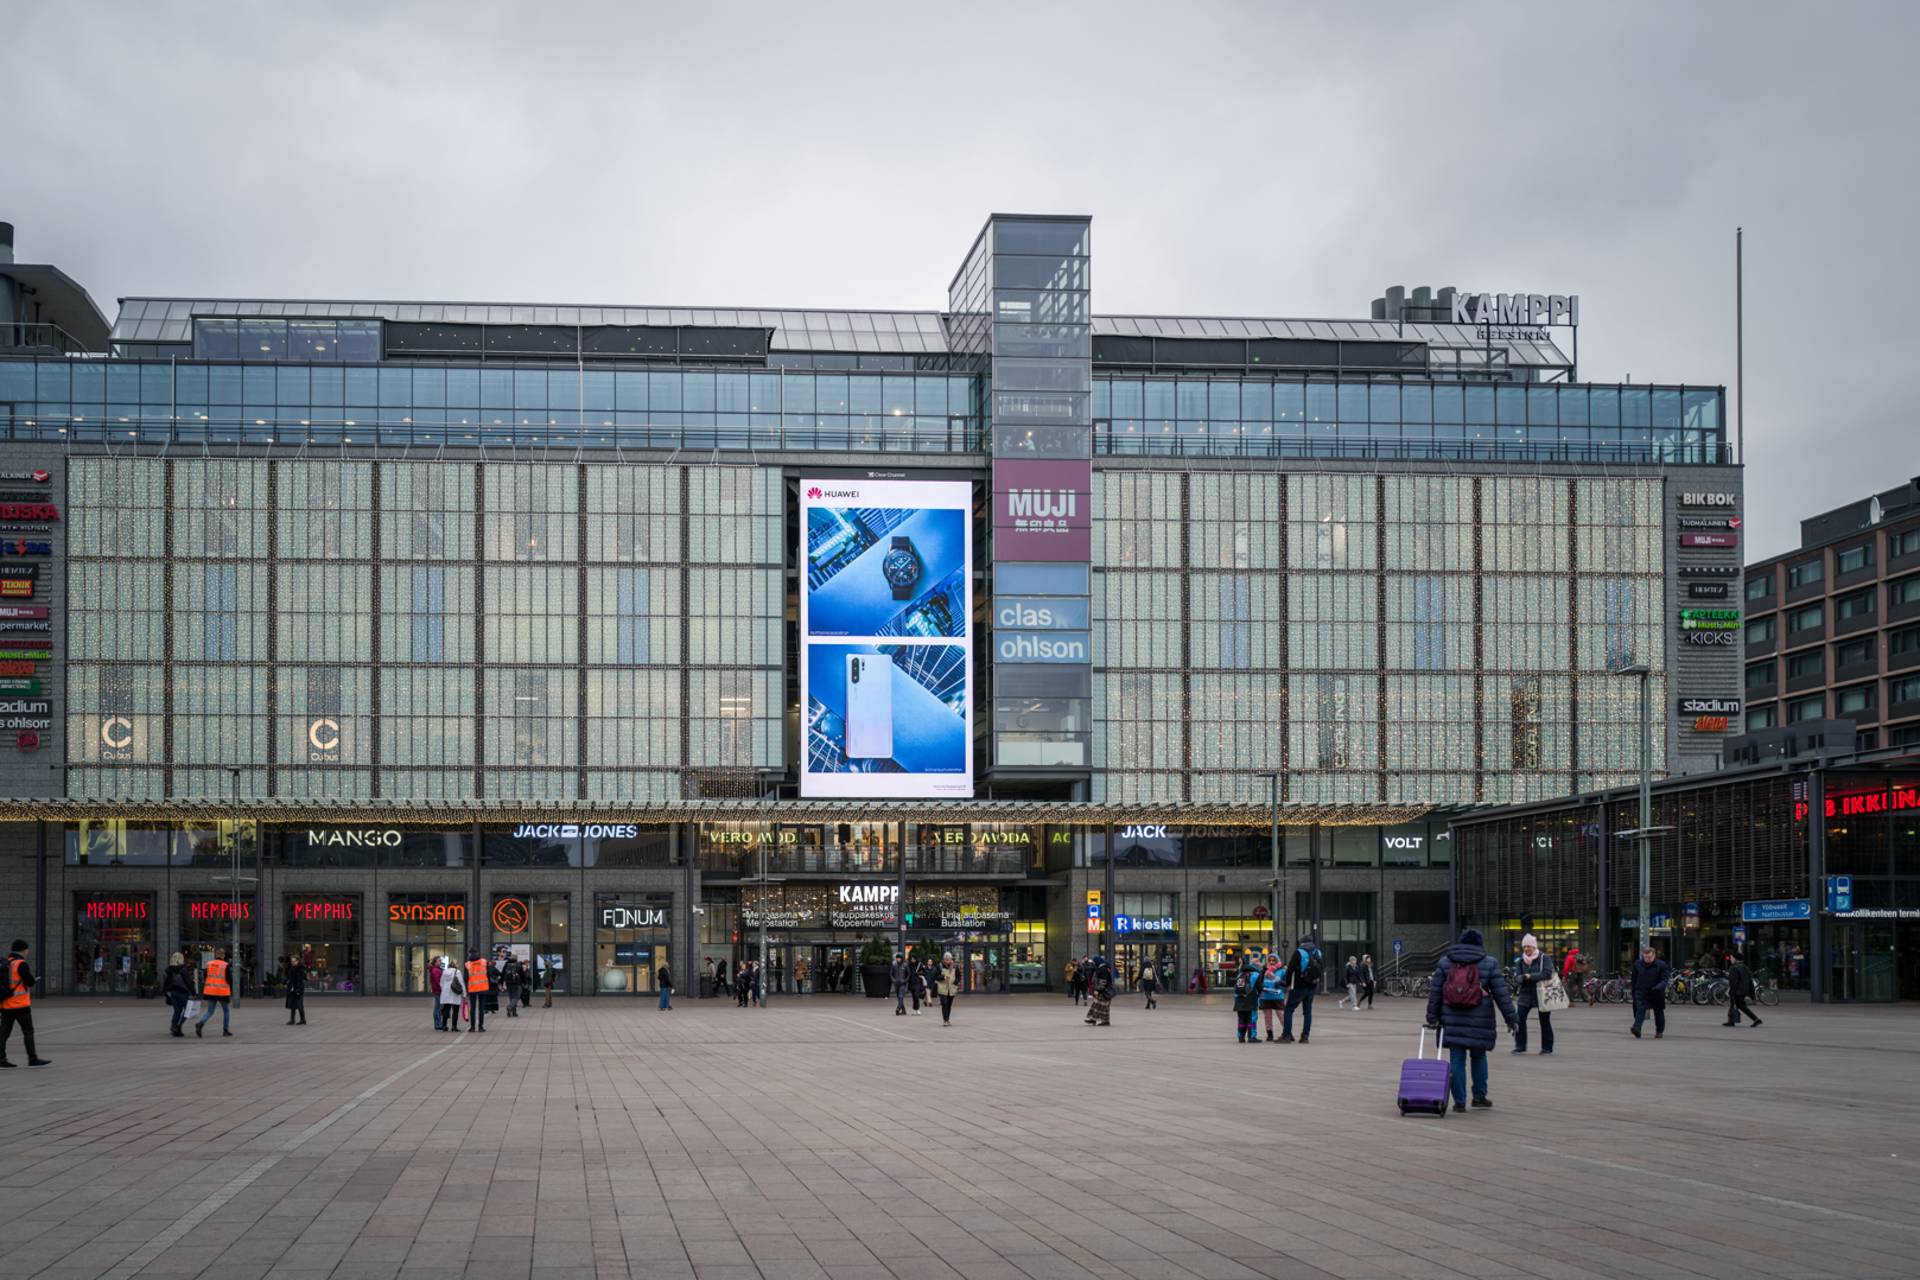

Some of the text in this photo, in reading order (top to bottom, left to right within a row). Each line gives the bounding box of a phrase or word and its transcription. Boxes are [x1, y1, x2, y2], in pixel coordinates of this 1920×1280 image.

[1451, 292, 1579, 327] KAMPPI
[1476, 330, 1551, 342] HELSINKI
[824, 489, 860, 499] HUAWEI
[1008, 488, 1076, 517] MUJI
[1682, 519, 1727, 527] SUOMALAINEN
[1694, 535, 1711, 545] MUJI
[2, 580, 31, 589] TEKNIK
[1000, 603, 1052, 626] clas
[1691, 610, 1741, 620] APTEEKKI
[0, 620, 48, 632] permarket
[1690, 631, 1734, 646] KICKS
[1001, 635, 1084, 659] ohlson
[1683, 699, 1739, 712] stadium
[7, 717, 50, 729] ohlson
[1335, 679, 1346, 768] CARLINGS
[103, 751, 132, 761] Cubus
[311, 751, 339, 761] Cubus
[1795, 788, 1920, 821] PB IKKUN
[513, 824, 637, 839] JACK JONES
[710, 831, 799, 844] VERO MD
[1121, 824, 1167, 839] JACK
[308, 829, 402, 847] MANGO
[1385, 837, 1423, 849] VOLT
[839, 885, 899, 903] KAMPP
[86, 901, 147, 919] MEMPHIS
[191, 902, 250, 919] MEMPHIS
[294, 903, 353, 920] MEMPHIS
[389, 904, 465, 921] SYNSAM
[852, 904, 893, 912] HELSINKI
[746, 910, 798, 920] Meroasema
[833, 911, 895, 922] Kauppakeskus
[941, 911, 1009, 923] Linja-autoasema
[746, 919, 798, 928] Merostation
[832, 918, 884, 929] Köpcentrum
[941, 920, 986, 928] Busstation
[1088, 919, 1100, 931] M
[1132, 917, 1174, 931] kioski
